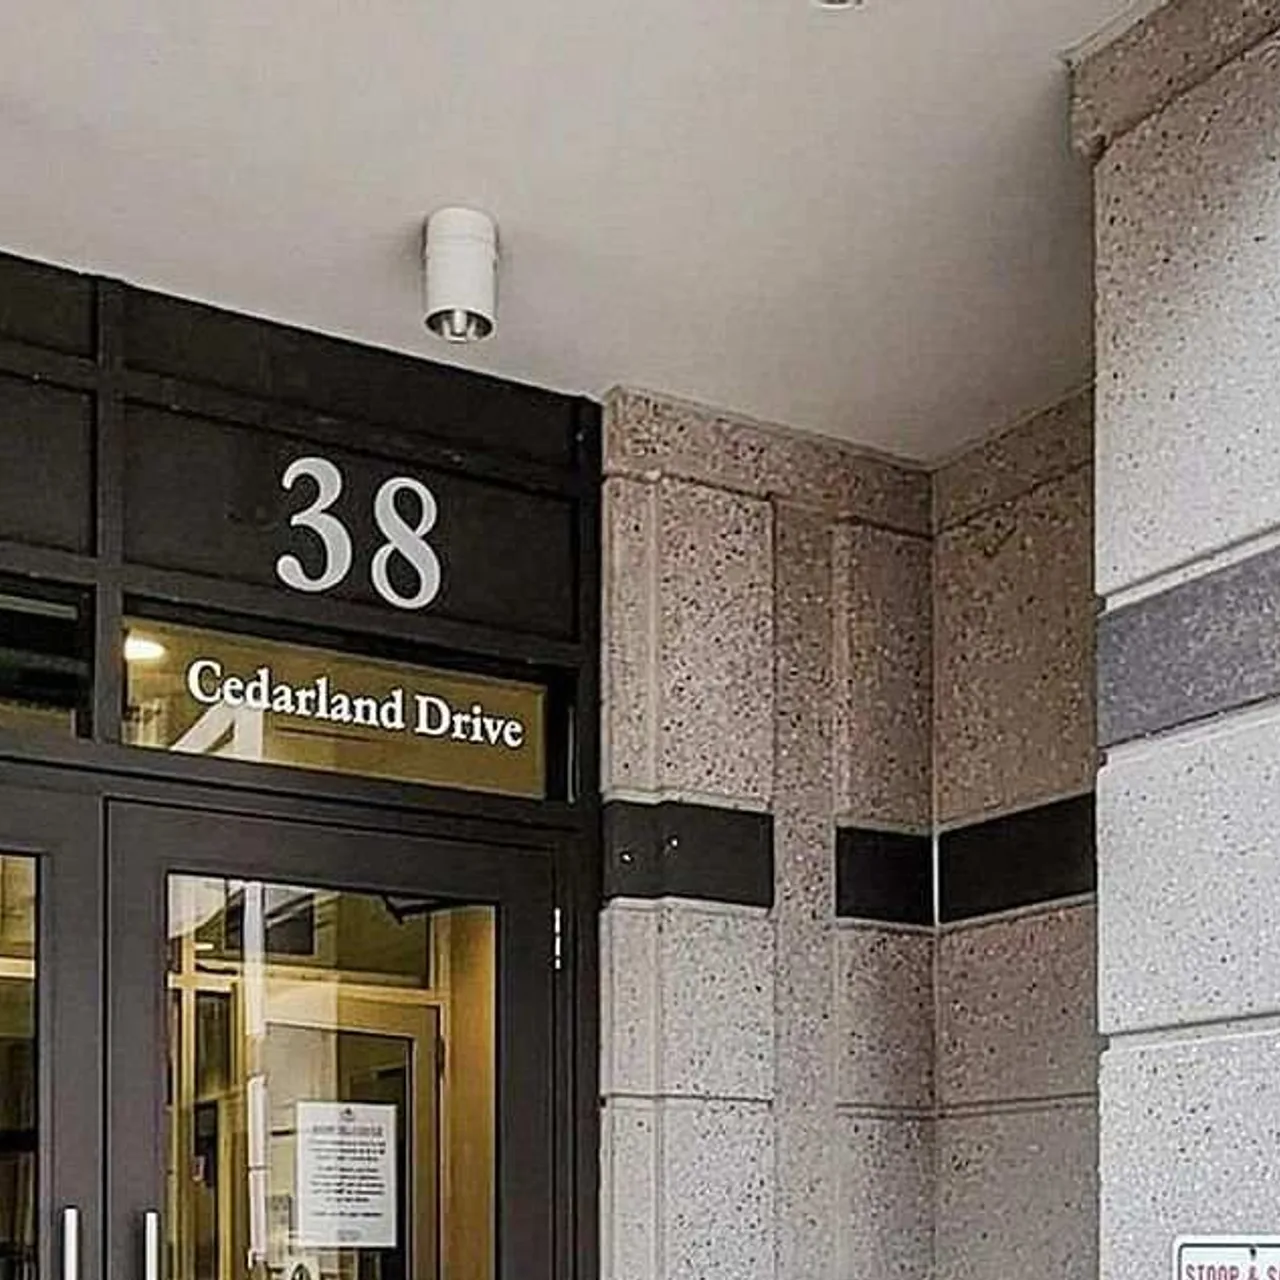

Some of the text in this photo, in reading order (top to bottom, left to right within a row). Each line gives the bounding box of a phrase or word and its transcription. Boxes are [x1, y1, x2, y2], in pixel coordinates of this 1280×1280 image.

[275, 456, 442, 610] 38
[186, 659, 524, 748] Cedarland Drive
